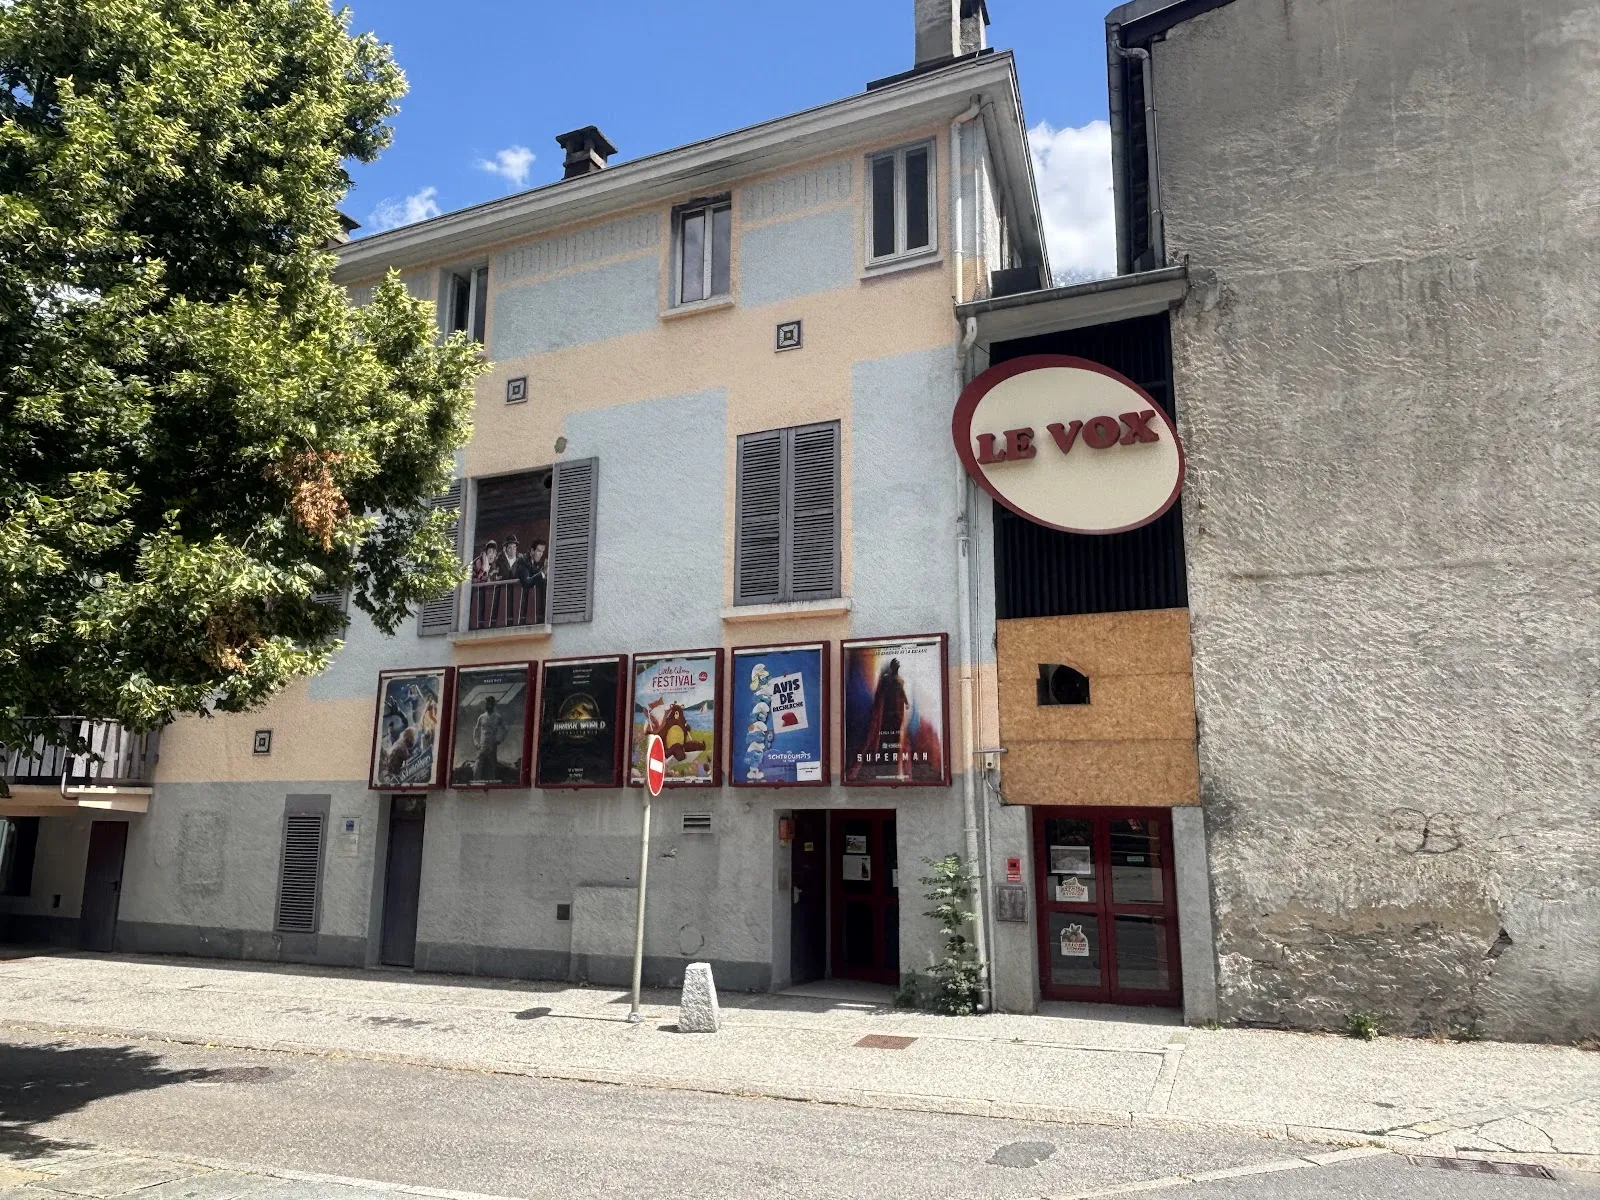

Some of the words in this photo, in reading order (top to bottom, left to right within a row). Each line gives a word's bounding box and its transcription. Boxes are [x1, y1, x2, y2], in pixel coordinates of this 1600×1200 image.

[976, 427, 1037, 464] LE
[1046, 409, 1160, 455] VOX
[652, 674, 696, 687] FESTIVAL
[773, 679, 800, 694] AVIS
[779, 692, 795, 705] DE
[553, 721, 579, 731] JURASSIC
[580, 720, 606, 730] WORLD
[856, 752, 928, 762] SUPERMAN
